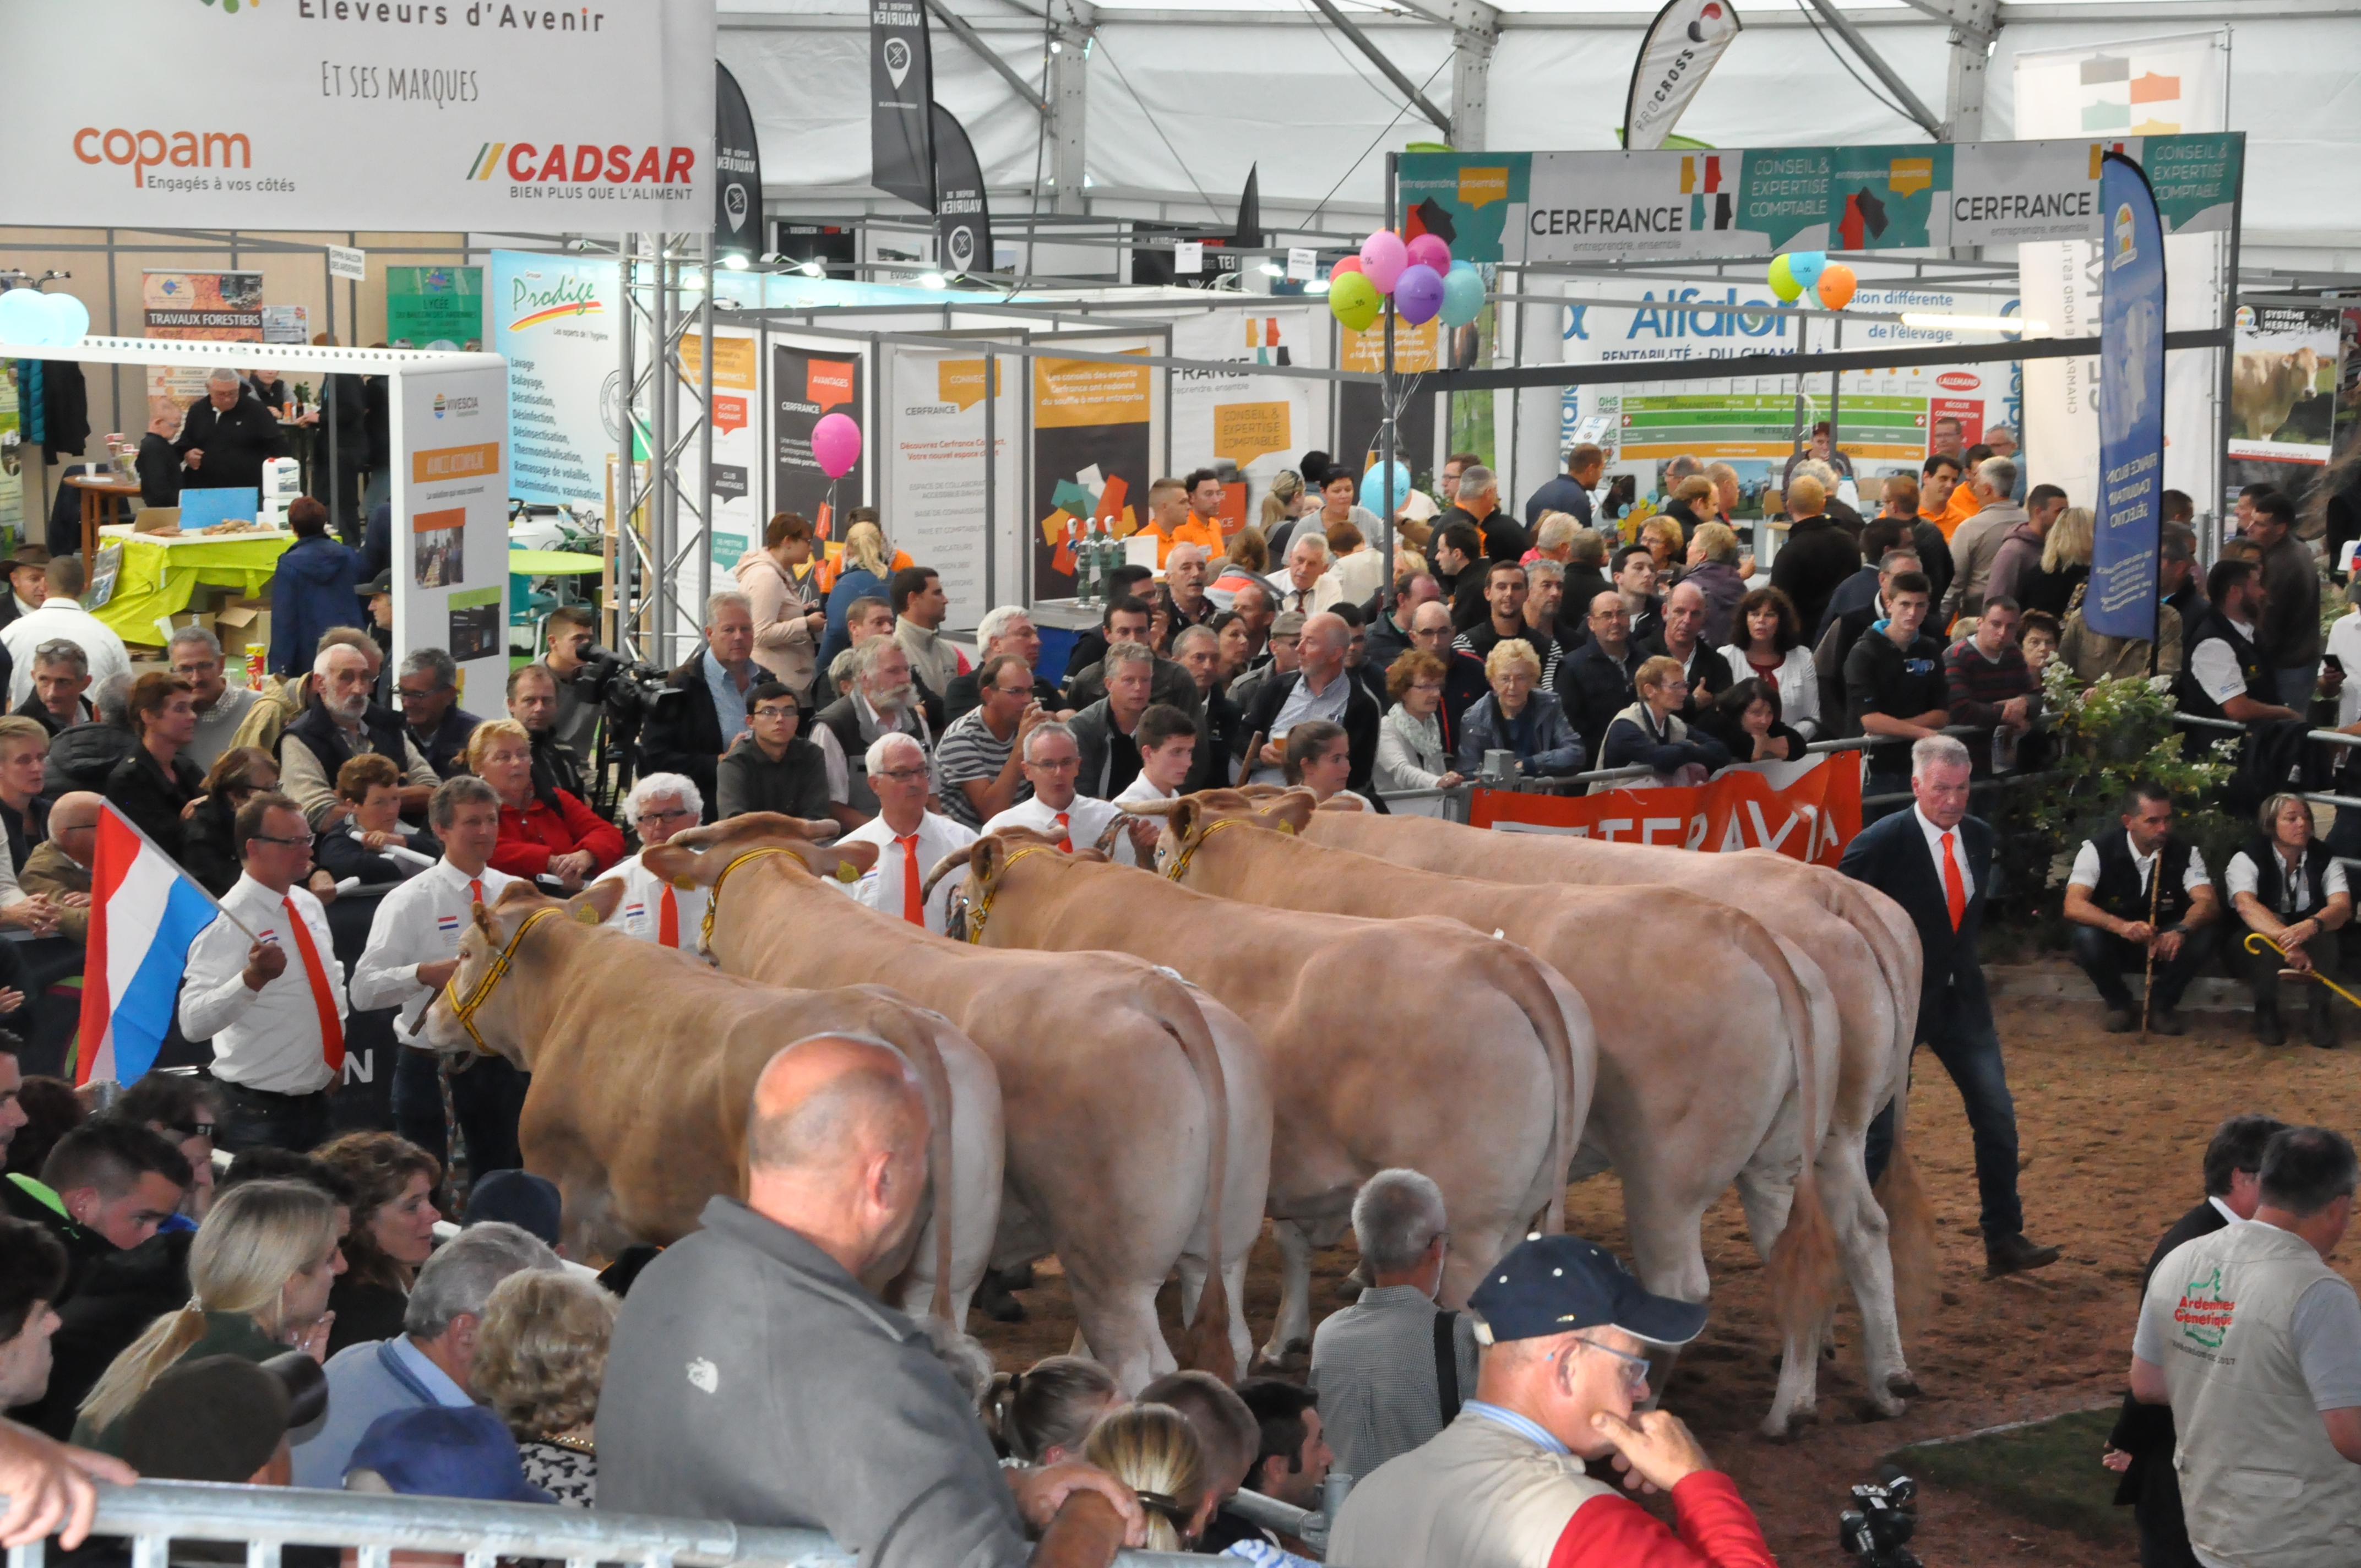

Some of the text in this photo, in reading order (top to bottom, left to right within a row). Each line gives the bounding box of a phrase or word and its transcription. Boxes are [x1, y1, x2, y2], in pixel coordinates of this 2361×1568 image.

[467, 3, 605, 32] d'Avenir
[73, 127, 252, 188] copam
[2155, 143, 2228, 161] CONSEIL &
[507, 143, 695, 183] CADSAR
[1754, 156, 1830, 175] CONSEIL &
[2153, 162, 2224, 181] EXPERTISE
[148, 176, 296, 192] Engagés à vos côtés
[1460, 177, 1506, 188] ensemble
[1751, 178, 1830, 196] EXPERTISE
[510, 186, 693, 201] BIEN PLUS QUE L'ALIMENT
[2153, 182, 2219, 200] COMPTABLE
[1749, 199, 1829, 217] COMPTABLE
[1955, 191, 2092, 221] CERFRANCE
[1531, 207, 1683, 236] CERFRANCE
[2049, 222, 2090, 234] ensemble
[1638, 239, 1682, 250] ensemble
[513, 275, 594, 315] Prodige
[1884, 290, 1954, 306] différente
[149, 313, 260, 325] TRAVAUX FORESTIERS
[1626, 287, 1799, 340] Alfalor
[2265, 309, 2305, 319] SYSTÈME
[1868, 324, 1953, 342] de l'élevage
[510, 357, 535, 372] Lavage
[512, 374, 545, 390] Balayage,
[812, 376, 848, 388] AVANTAGES
[950, 374, 986, 384] CONNEC
[1047, 370, 1138, 382] Les conseils des experts
[1938, 377, 1979, 386] LALLEMAND
[1051, 384, 1087, 394] Cerfrance
[1103, 380, 1136, 390] redonné
[1215, 382, 1249, 392] ensemble
[447, 396, 478, 410] VIVESCIA
[512, 392, 555, 408] Dératisation,
[1106, 393, 1145, 403] entreprise
[1944, 400, 1971, 409] RÉCOLTE
[781, 401, 820, 414] CERFRANCE
[905, 406, 956, 416] CERFRANCE
[1223, 407, 1281, 422] CONSEIL &
[513, 409, 556, 426] Désinfection,
[513, 426, 569, 445] Désinsectisation,
[1223, 422, 1280, 435] EXPERTISE
[1606, 429, 1617, 439] HS
[900, 441, 938, 449] Découvrez
[939, 440, 974, 448] Cerfrance
[1223, 435, 1280, 449] COMPTABLE
[514, 443, 583, 464] Thermonébulisation,
[928, 451, 953, 460] nouvel
[954, 451, 978, 460] espace
[514, 460, 591, 483] Ramassage de volailles,
[515, 478, 560, 496] Insémination,
[715, 480, 744, 490] AVANTAGES
[942, 507, 986, 515] CONNAISSANC
[2179, 1295, 2235, 1311] Ardennes
